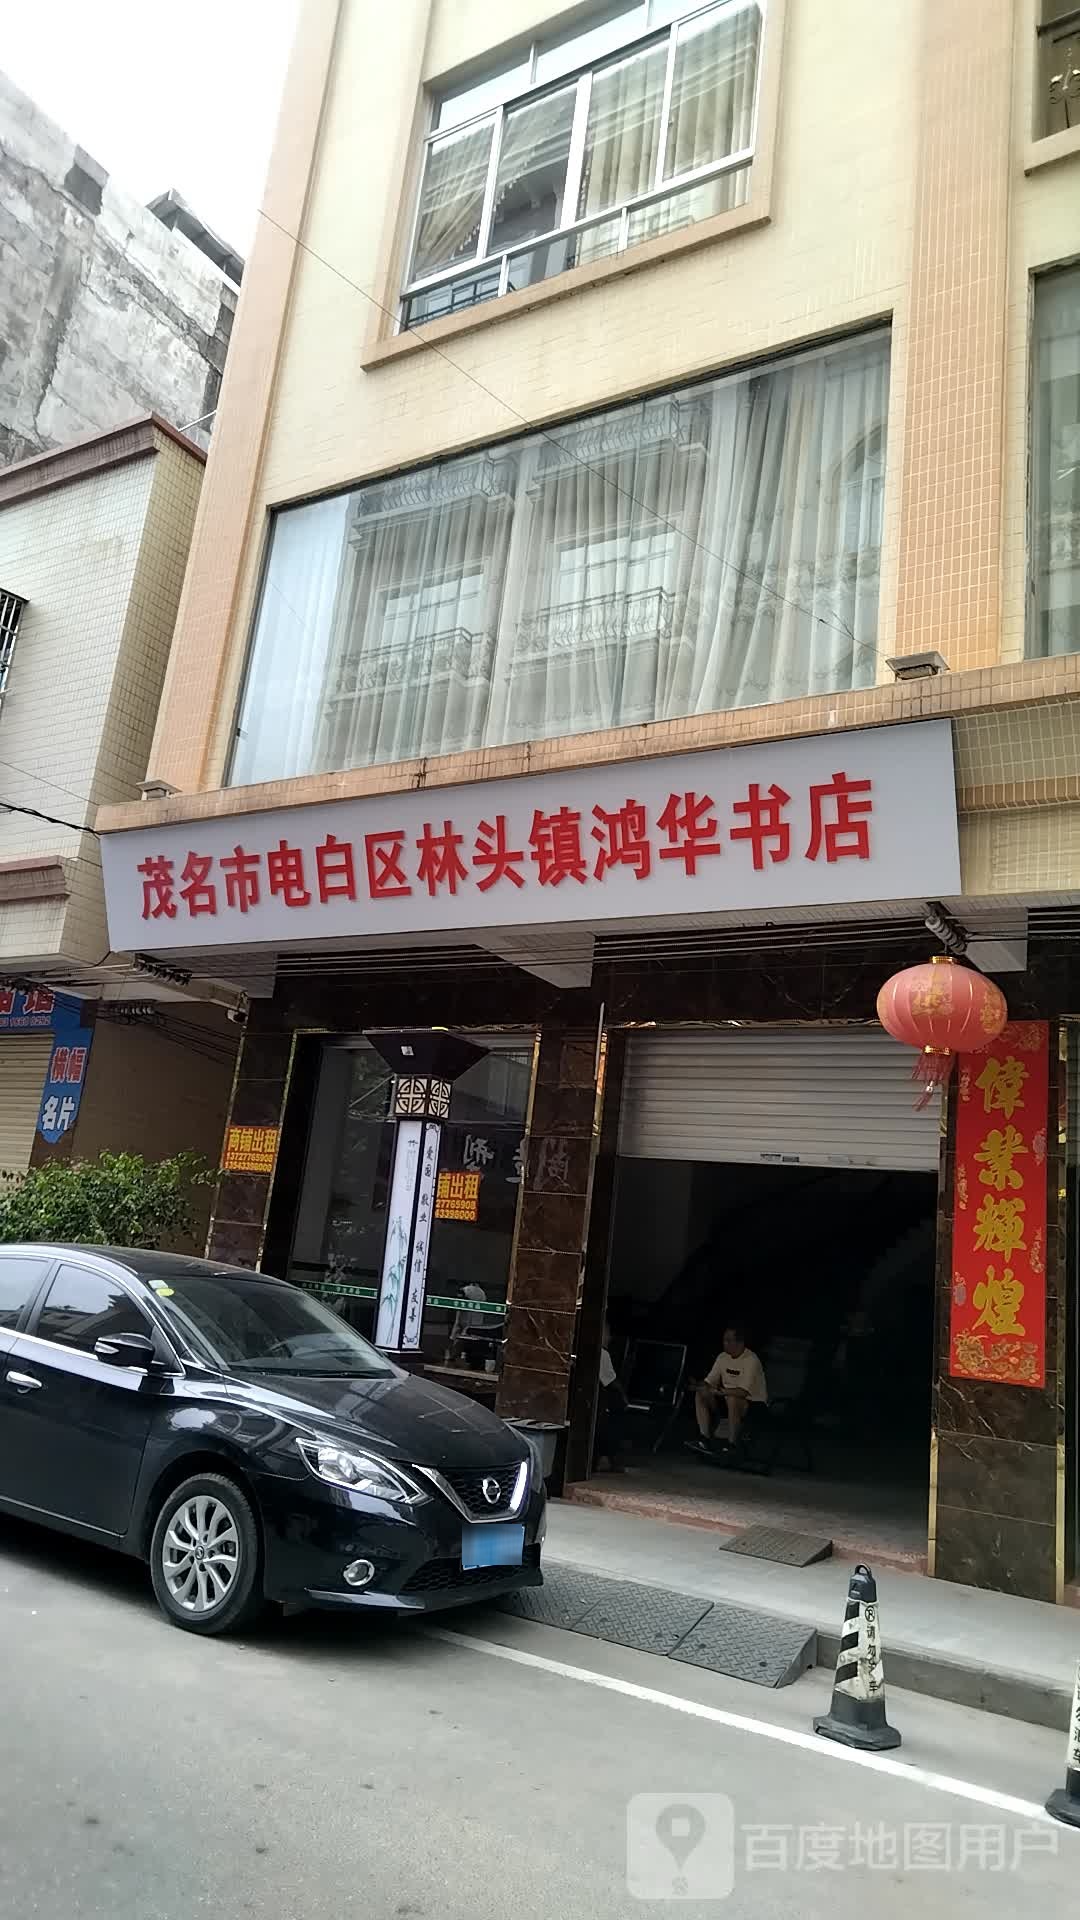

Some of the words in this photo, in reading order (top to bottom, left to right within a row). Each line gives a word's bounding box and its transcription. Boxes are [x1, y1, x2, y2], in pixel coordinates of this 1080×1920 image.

[137, 772, 873, 920] 茂名市电白区林头镇鸿华书店
[50, 1046, 87, 1084] 横幅
[42, 1095, 75, 1131] 名片
